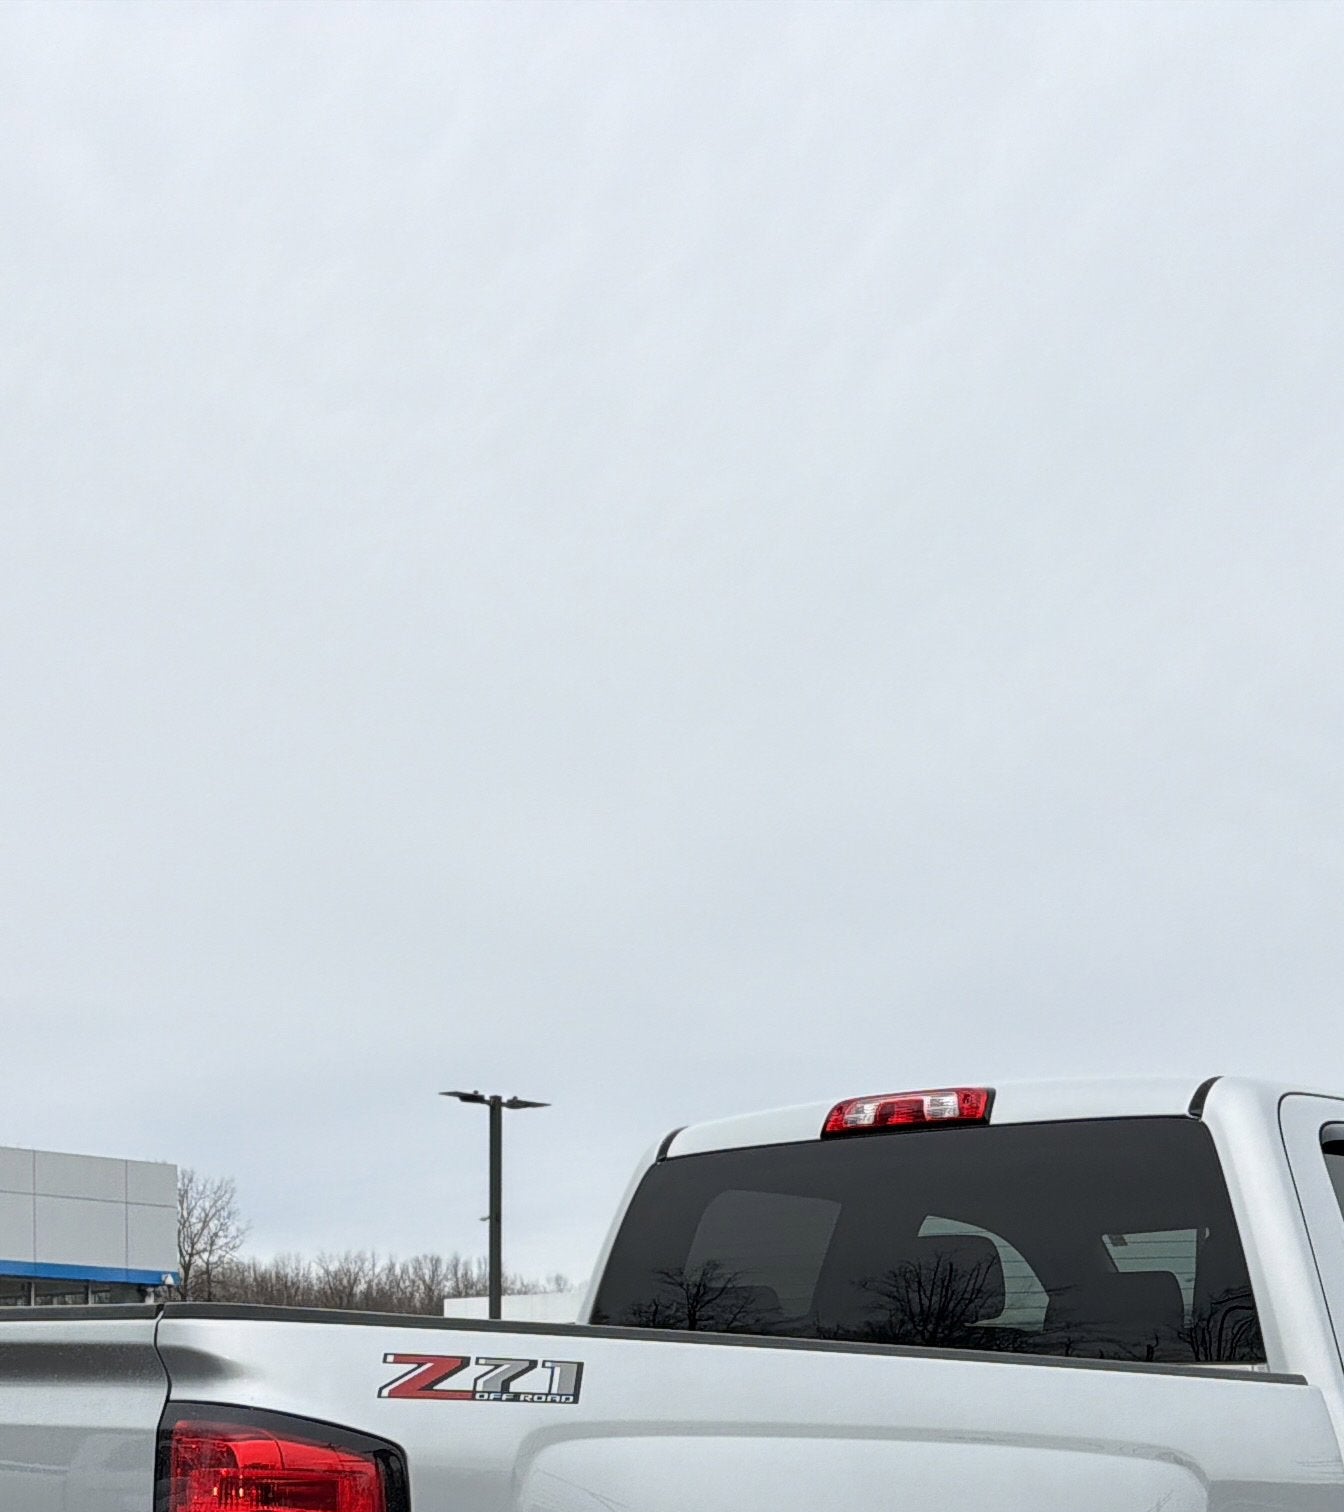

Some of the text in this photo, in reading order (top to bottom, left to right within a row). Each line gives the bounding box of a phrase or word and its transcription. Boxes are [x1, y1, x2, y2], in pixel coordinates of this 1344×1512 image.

[377, 1352, 585, 1404] Z71
[475, 1392, 575, 1404] OFF ROAD
